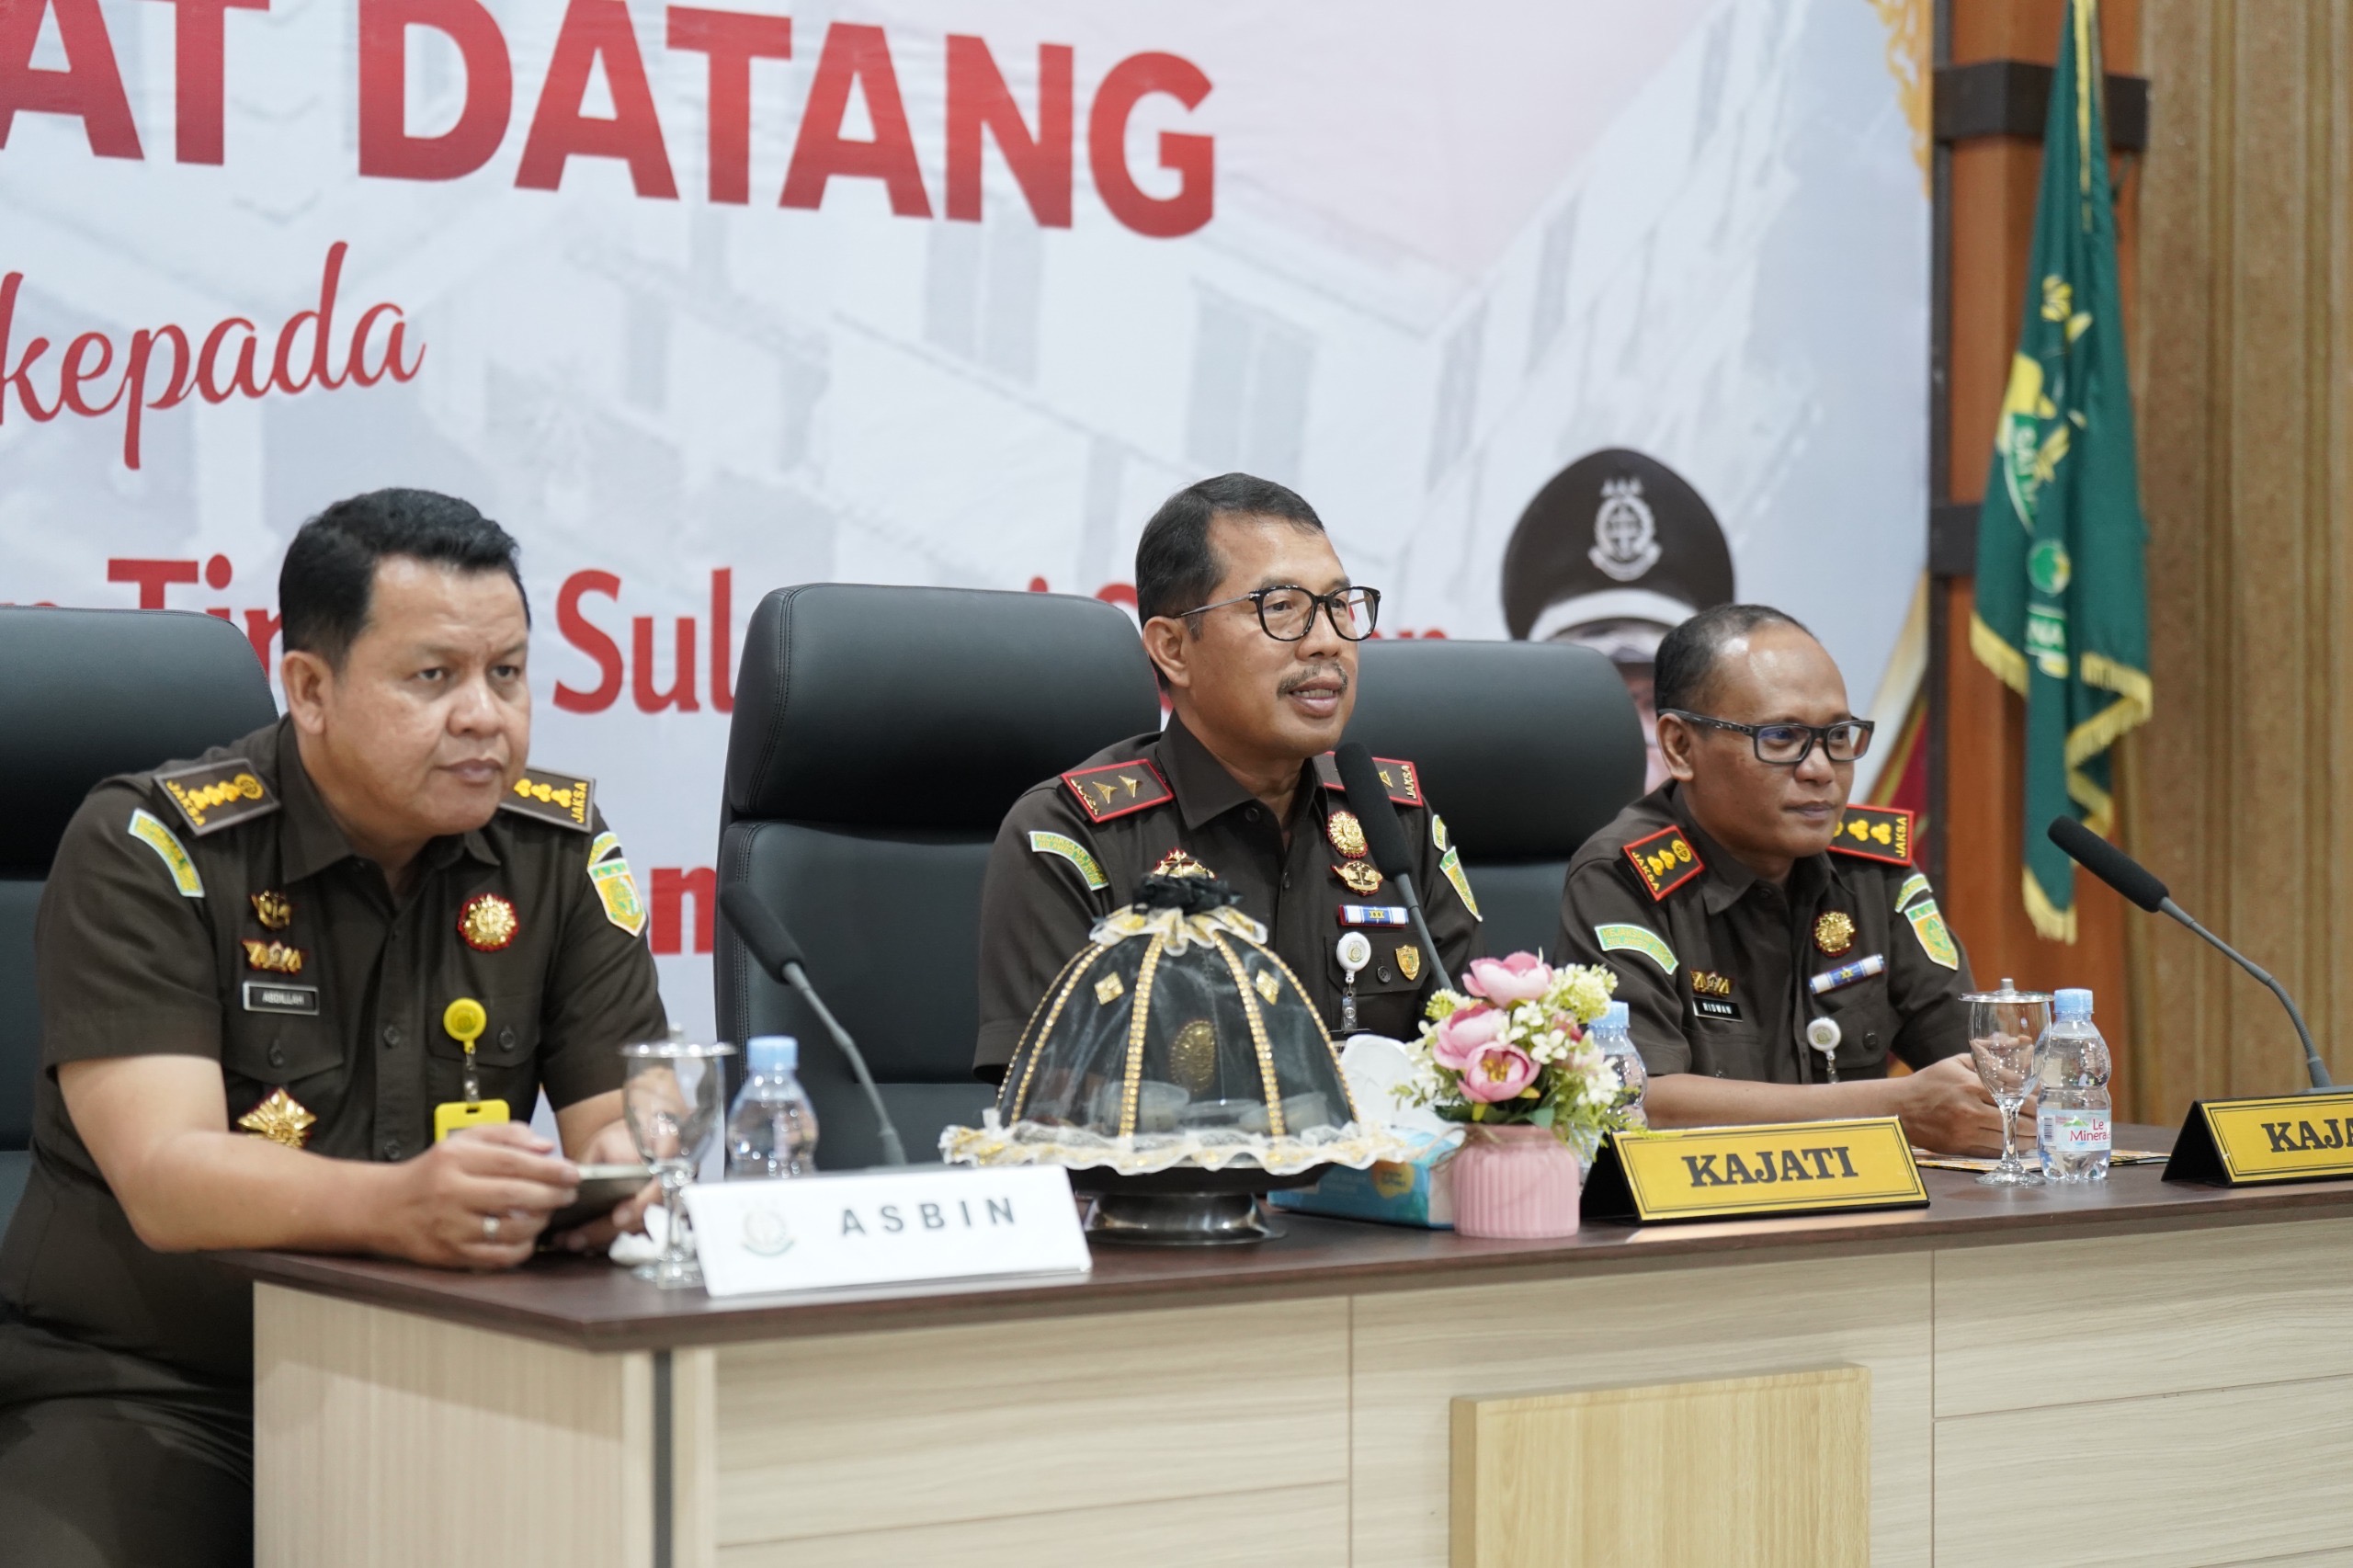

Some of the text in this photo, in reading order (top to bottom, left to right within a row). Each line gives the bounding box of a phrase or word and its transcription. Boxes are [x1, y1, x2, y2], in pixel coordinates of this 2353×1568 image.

[358, 0, 1214, 239] DATANG
[0, 241, 426, 470] kepada
[553, 567, 734, 714] Sul
[571, 782, 588, 824] JAKSA
[1402, 765, 1416, 800] JAKSA
[1895, 817, 1907, 858] JAKSA
[1631, 852, 1660, 891] JAKSA
[2093, 1119, 2104, 1131] Le
[1681, 1146, 1859, 1187] KAJATI
[843, 1197, 1015, 1236] ASBIN
